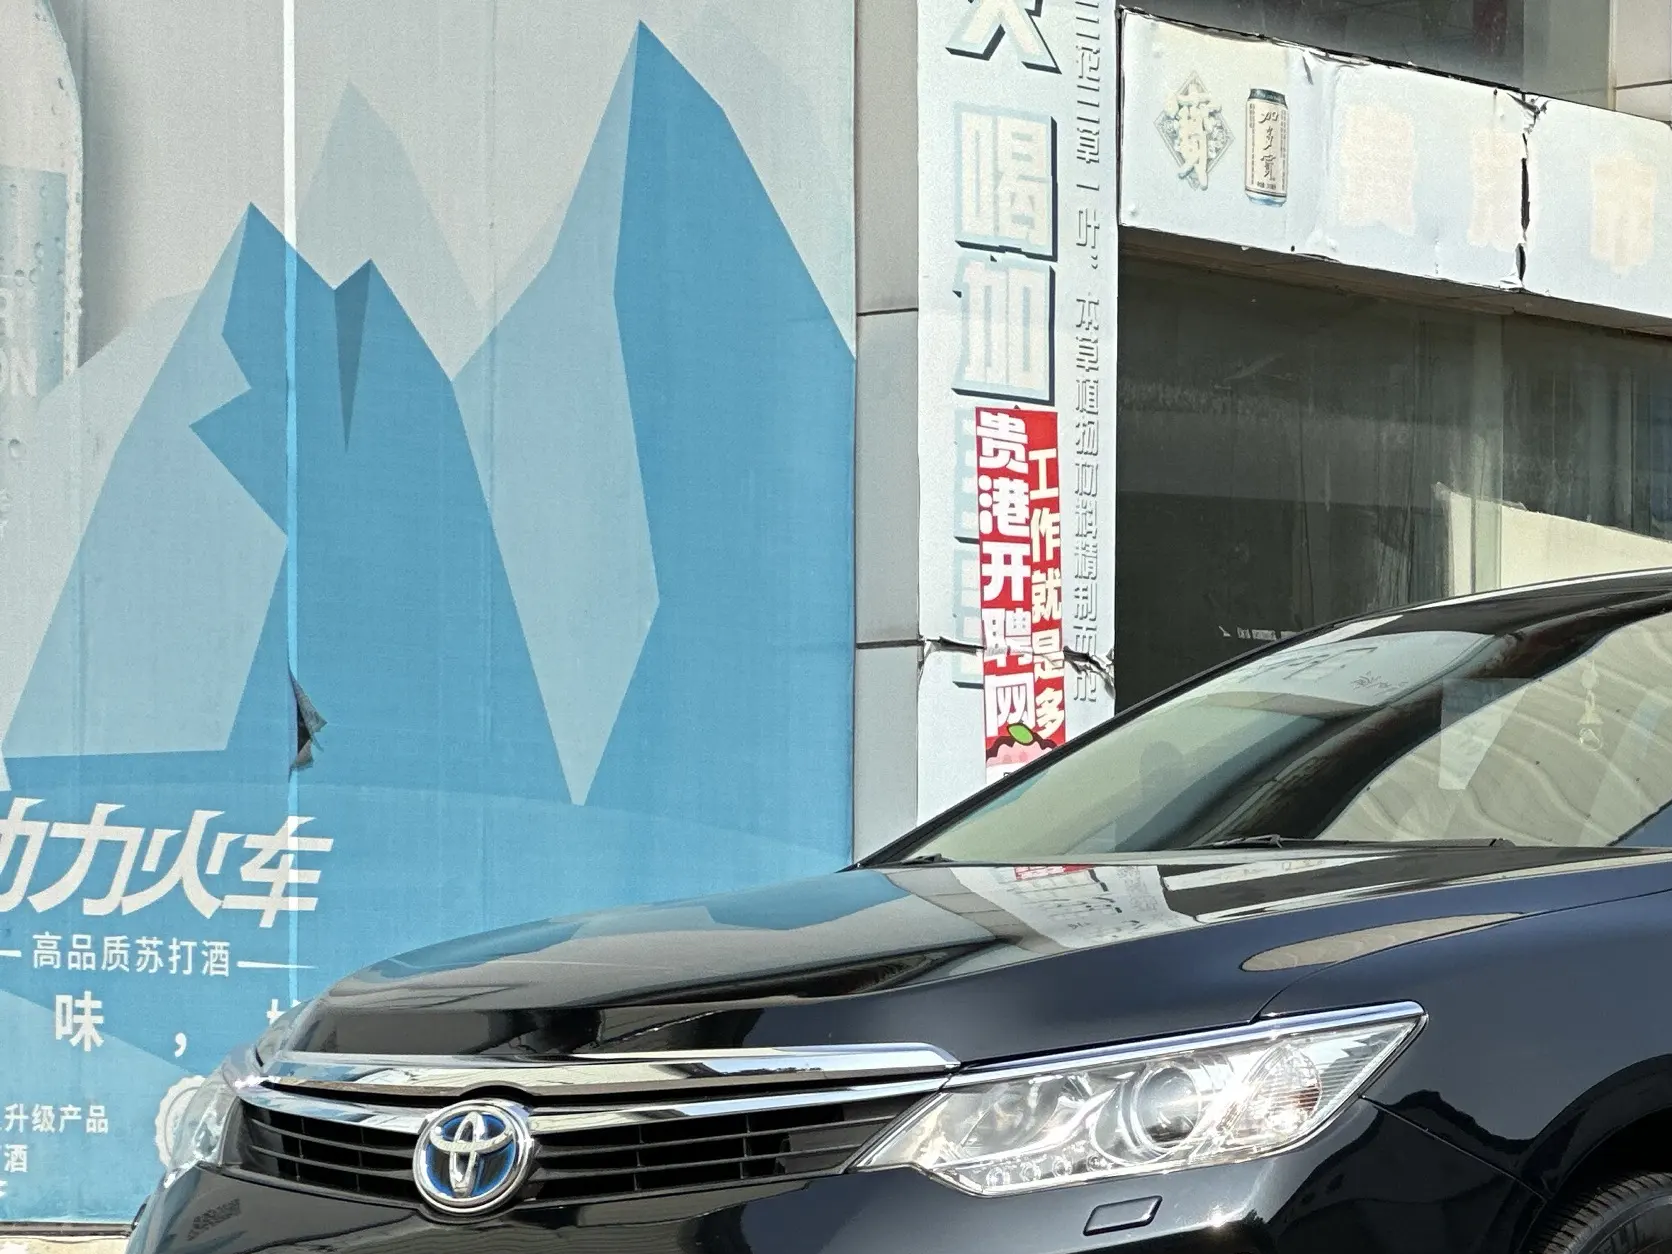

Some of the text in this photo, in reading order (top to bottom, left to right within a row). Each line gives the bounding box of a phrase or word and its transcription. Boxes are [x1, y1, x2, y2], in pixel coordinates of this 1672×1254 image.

[976, 411, 1035, 737] 贵港开聘网
[1028, 447, 1066, 740] 工作就是多
[31, 931, 231, 977] 高品质苏打酒
[4, 1103, 109, 1134] 升级产品
